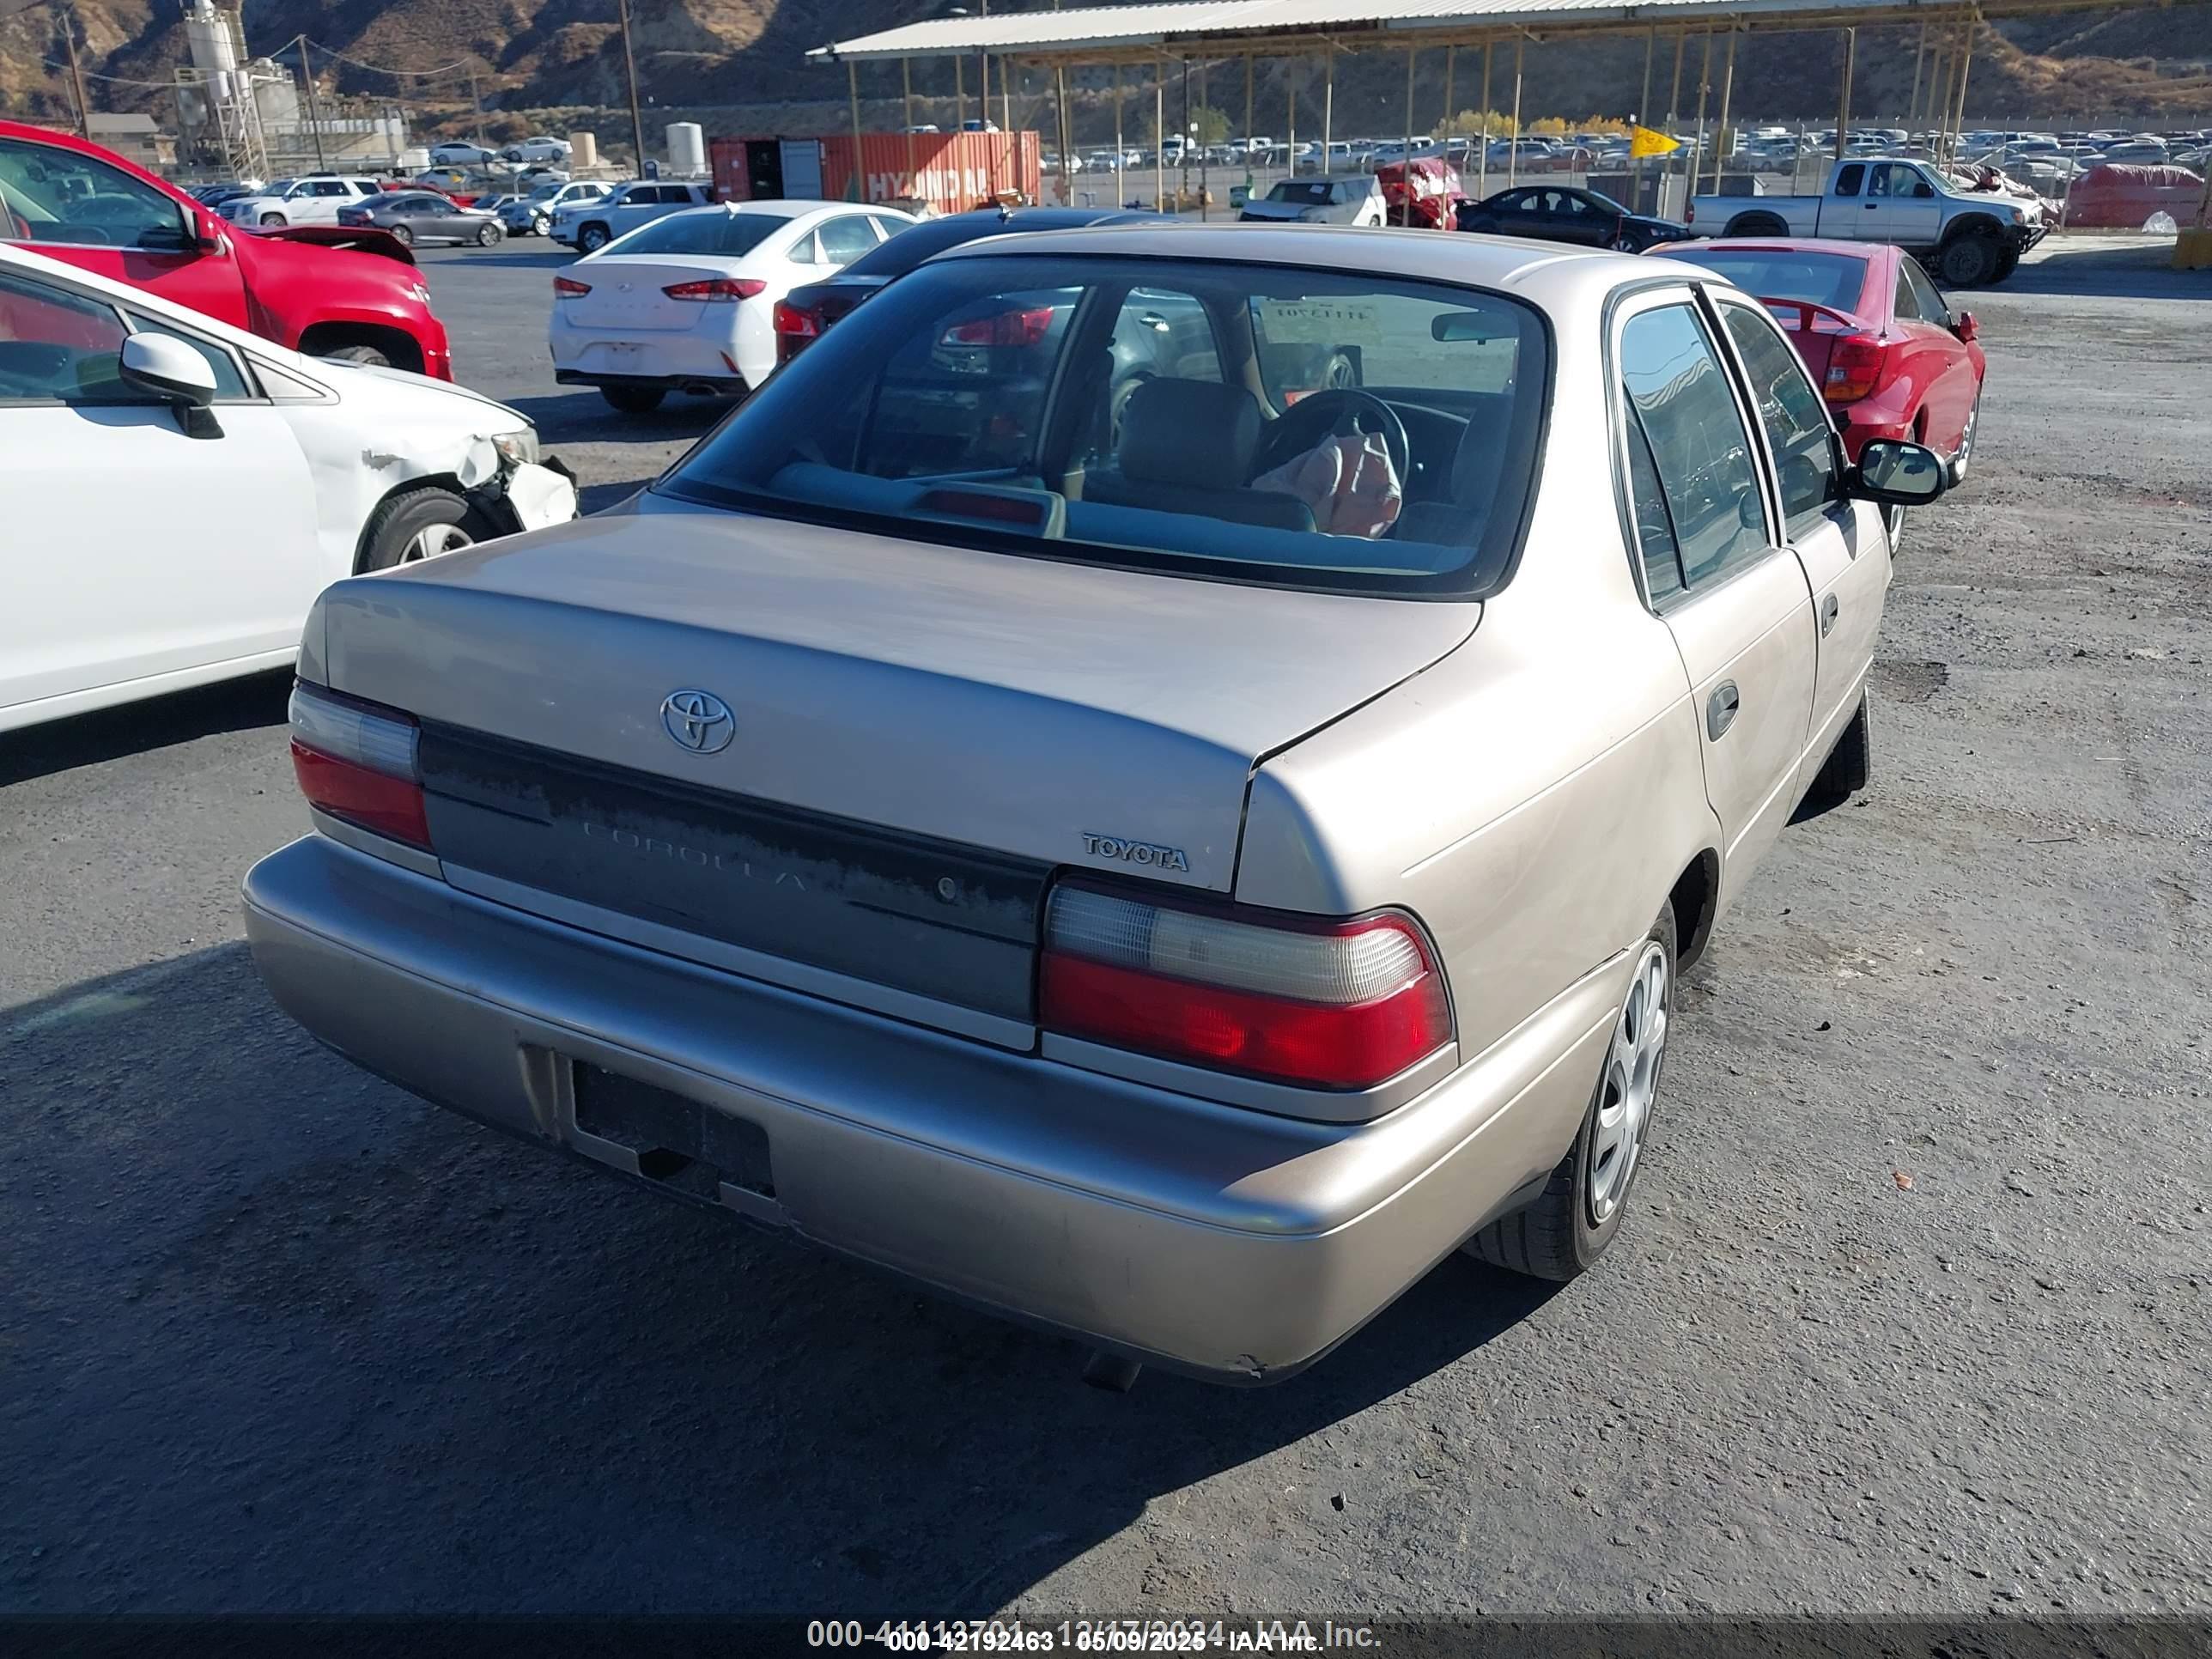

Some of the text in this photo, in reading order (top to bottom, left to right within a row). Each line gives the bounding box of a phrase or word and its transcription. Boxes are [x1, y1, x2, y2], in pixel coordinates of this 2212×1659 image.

[867, 169, 988, 202] HYUNDAI
[583, 822, 805, 891] COROLLA
[1082, 832, 1188, 872] TOYOTA
